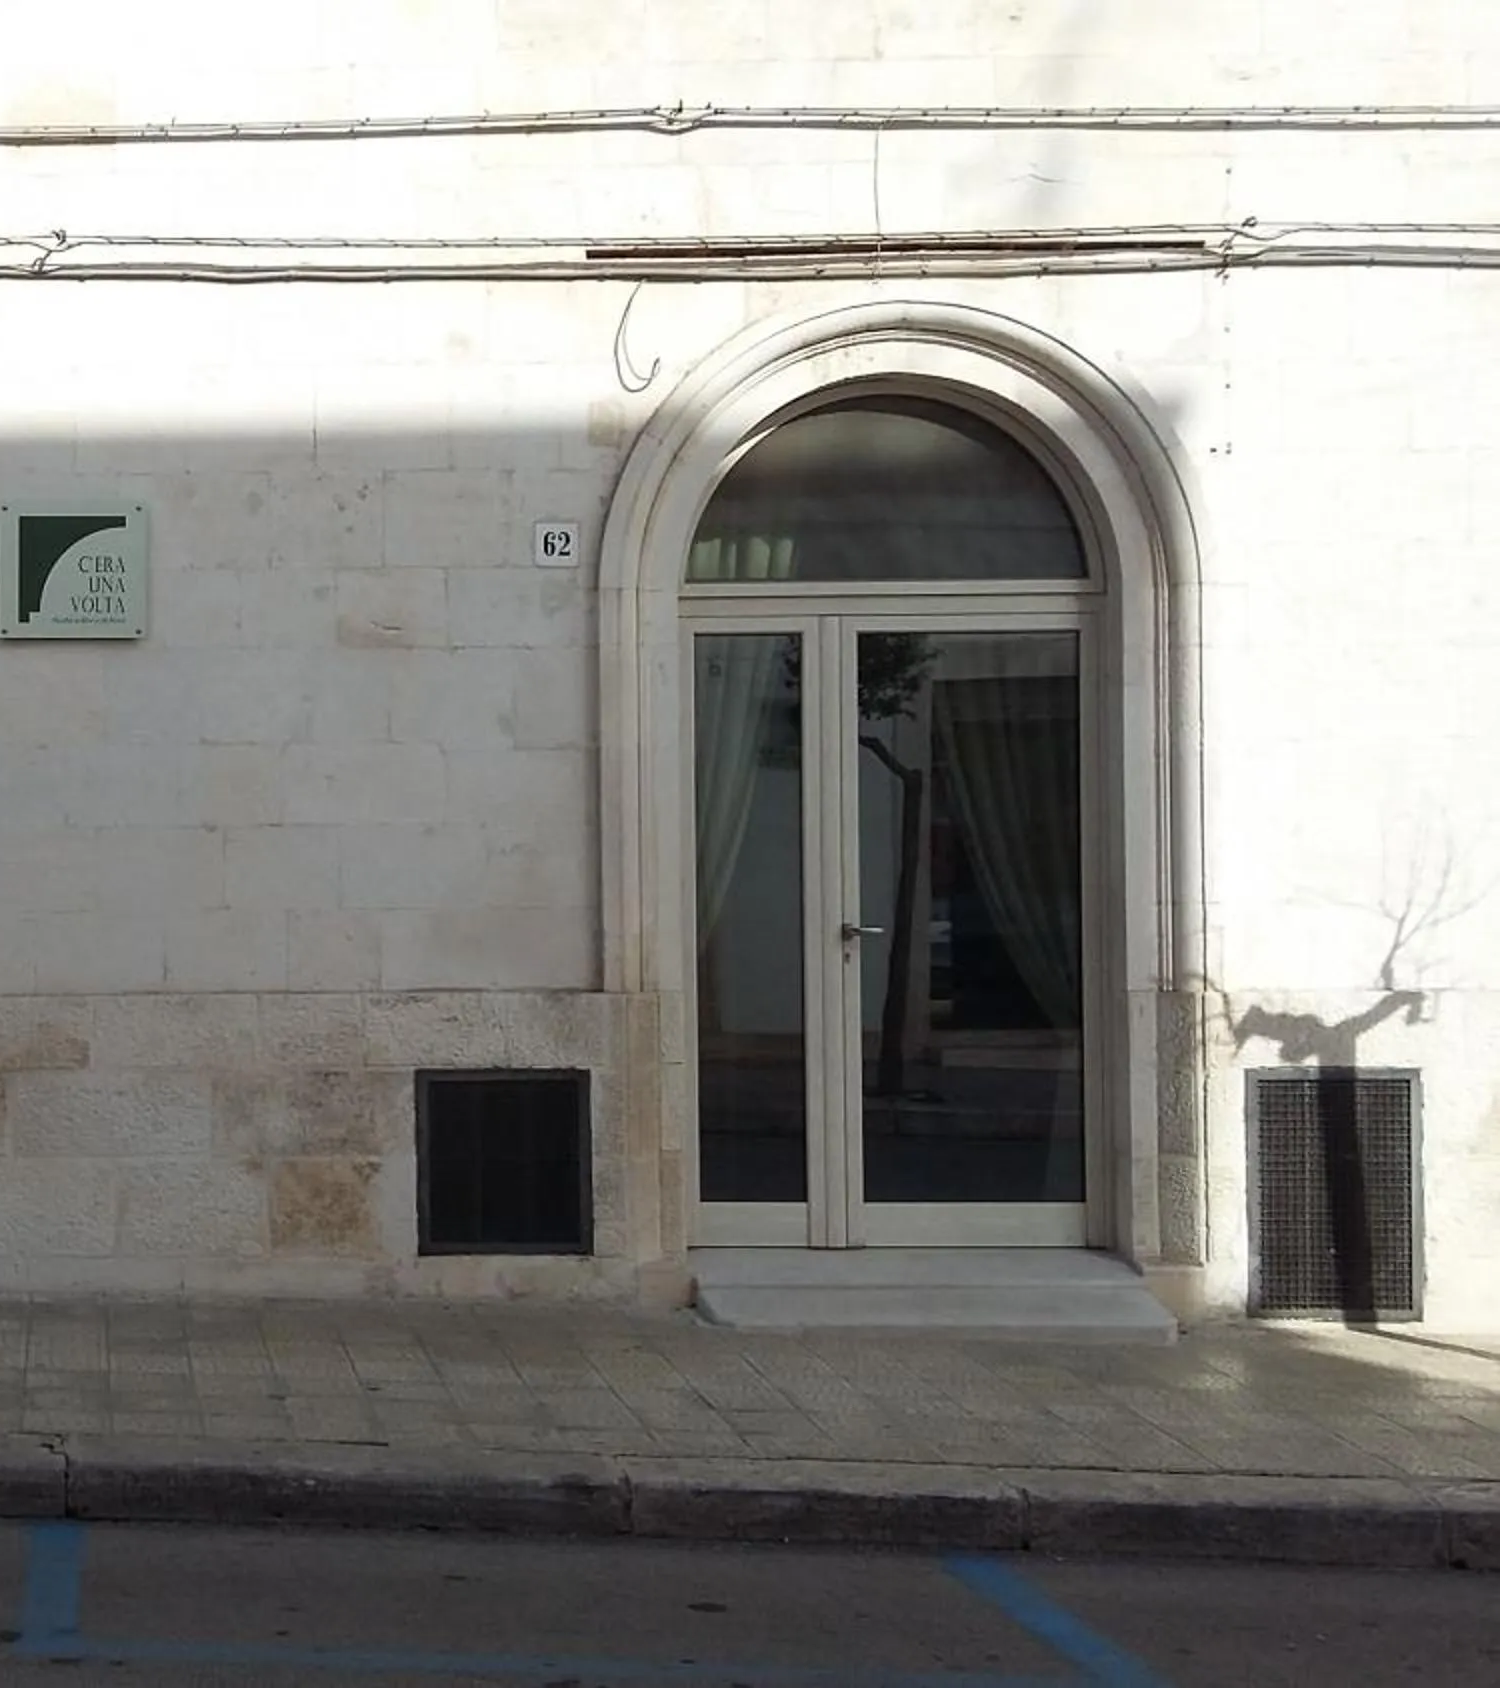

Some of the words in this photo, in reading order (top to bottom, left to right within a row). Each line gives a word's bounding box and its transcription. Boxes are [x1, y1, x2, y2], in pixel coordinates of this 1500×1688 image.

[543, 531, 571, 557] 62
[88, 576, 126, 593] UNA
[70, 596, 126, 613] VOLTA
